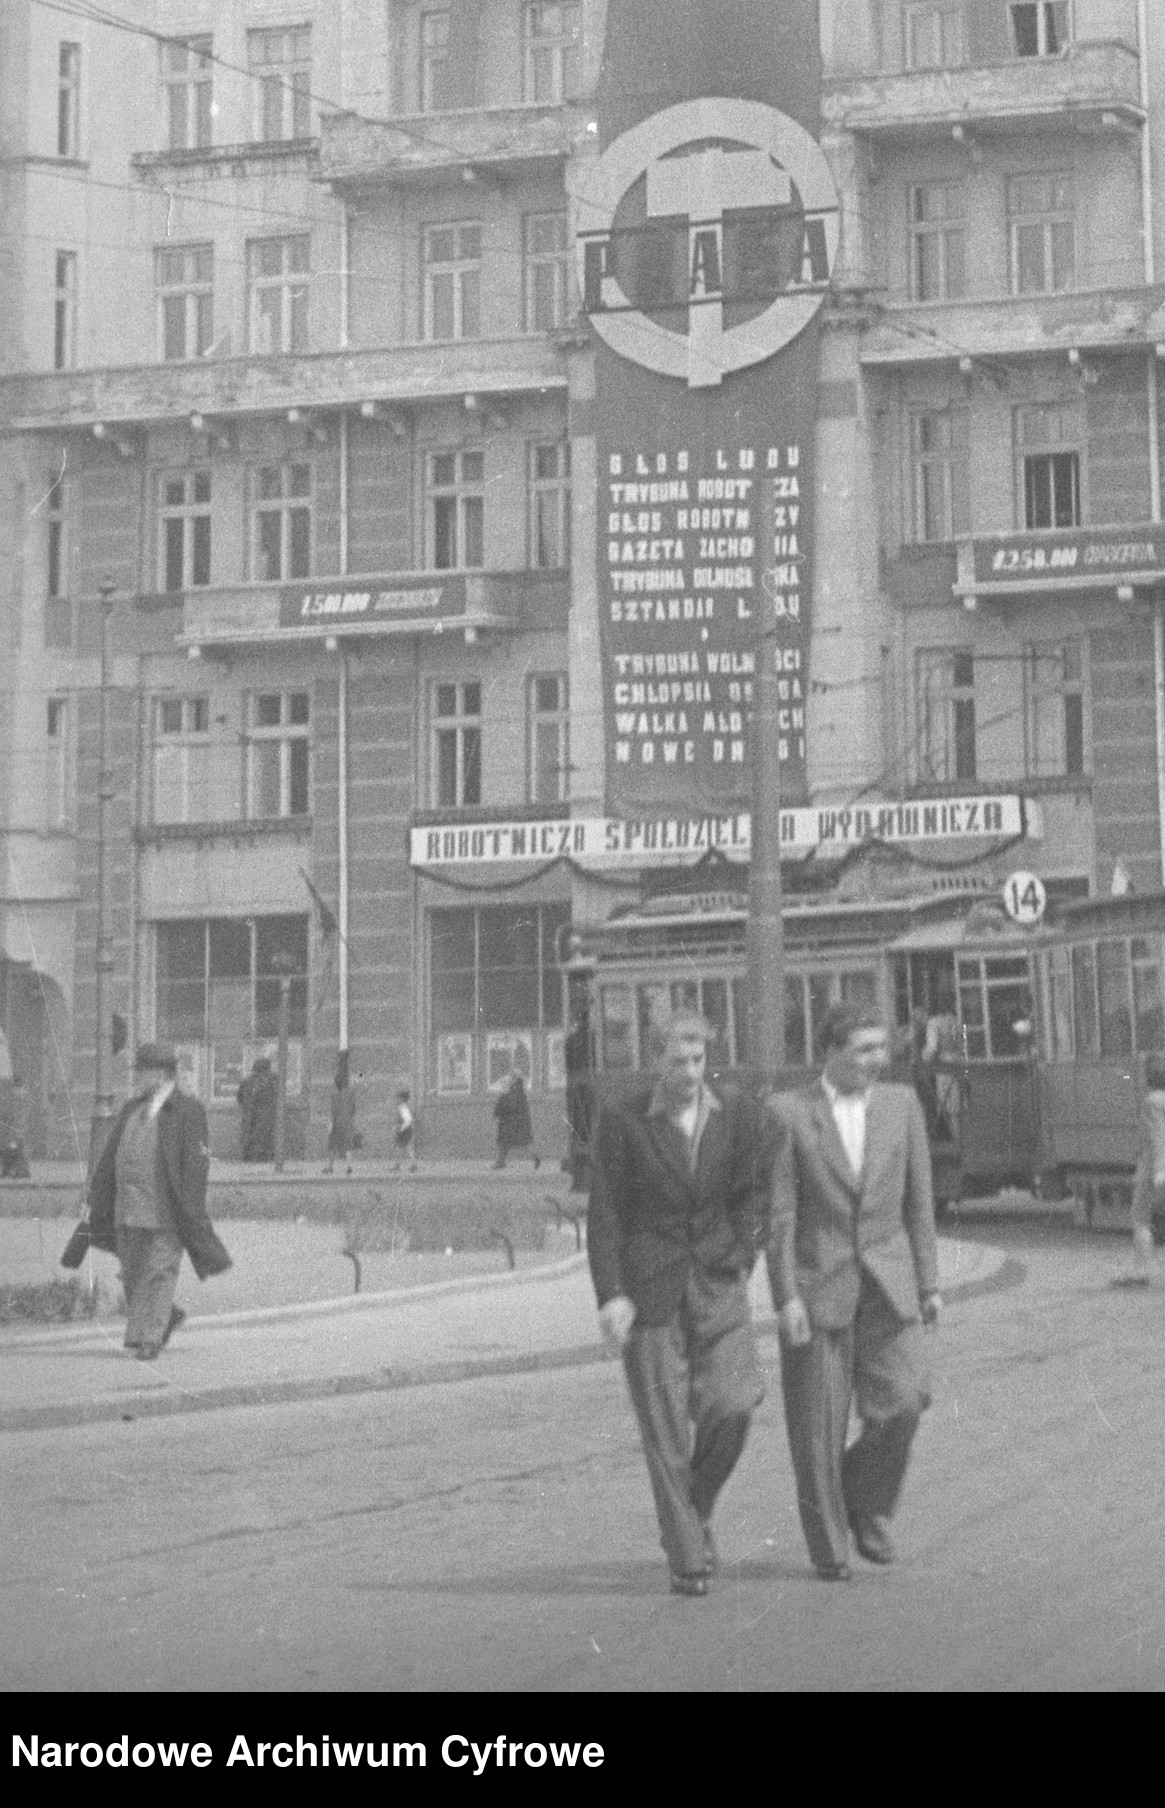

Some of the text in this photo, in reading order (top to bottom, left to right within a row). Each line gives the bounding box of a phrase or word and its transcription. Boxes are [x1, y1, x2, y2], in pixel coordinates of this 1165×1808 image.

[716, 445, 800, 470] LUDU
[609, 476, 800, 504] TRYBUNA ROBOTZA
[677, 505, 800, 530] ROBOTNZY
[608, 538, 685, 563] GAZETA
[610, 594, 800, 622] SZTANDAR LDU
[427, 824, 585, 859] ROBOTNICZA
[818, 802, 1002, 839] WYDAWNICZA
[1011, 880, 1041, 915] 14
